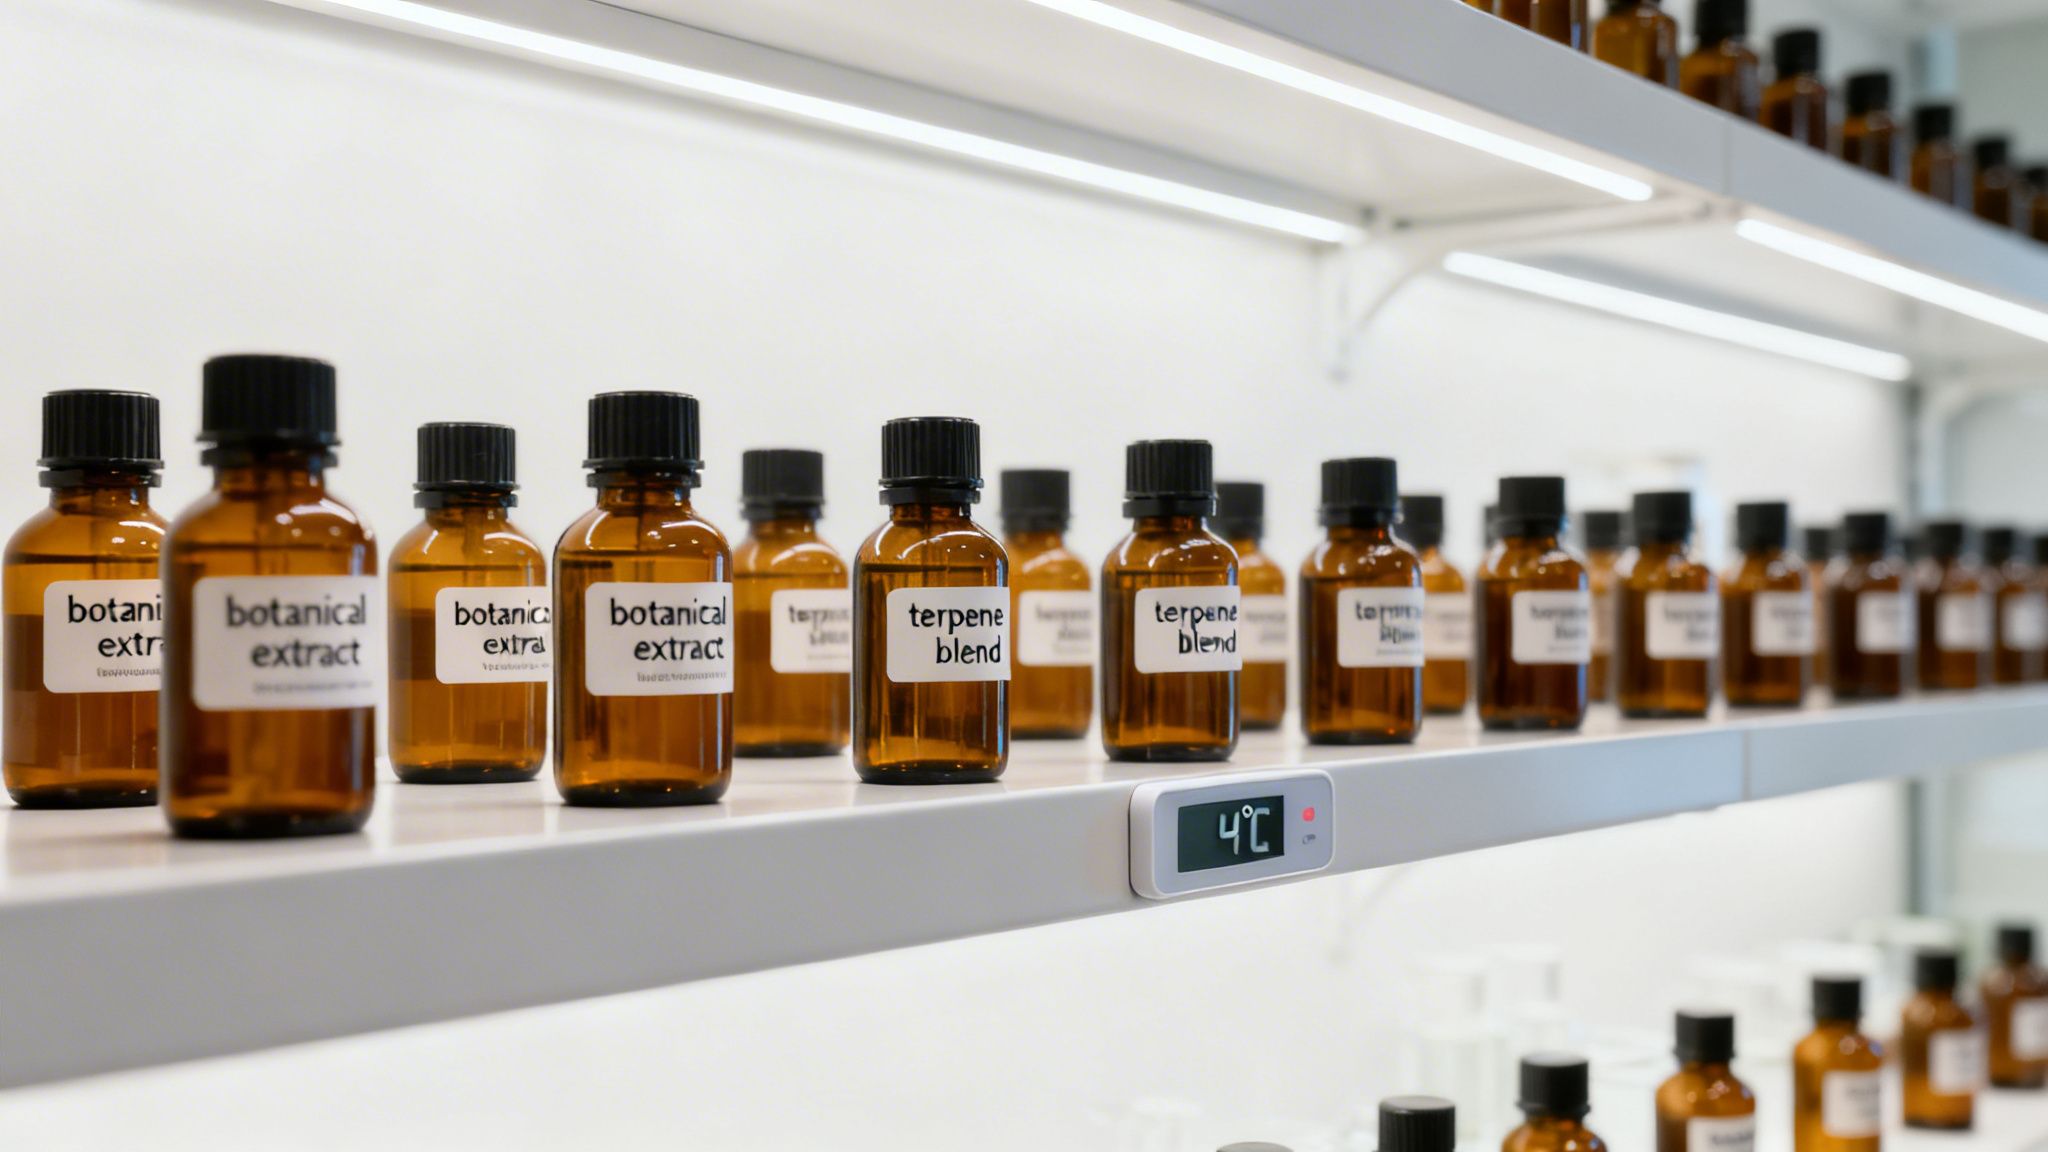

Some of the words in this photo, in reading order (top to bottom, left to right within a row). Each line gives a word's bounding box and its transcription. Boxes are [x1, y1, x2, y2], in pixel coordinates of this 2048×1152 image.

[225, 596, 366, 627] botanical
[610, 595, 726, 626] botanical
[908, 602, 1004, 635] terpene
[1155, 601, 1238, 631] terpene
[98, 632, 165, 657] extr
[251, 640, 361, 668] extract
[634, 637, 725, 661] extract
[936, 634, 1002, 664] blend
[1178, 628, 1236, 654] blend
[1219, 804, 1271, 855] 4°C
